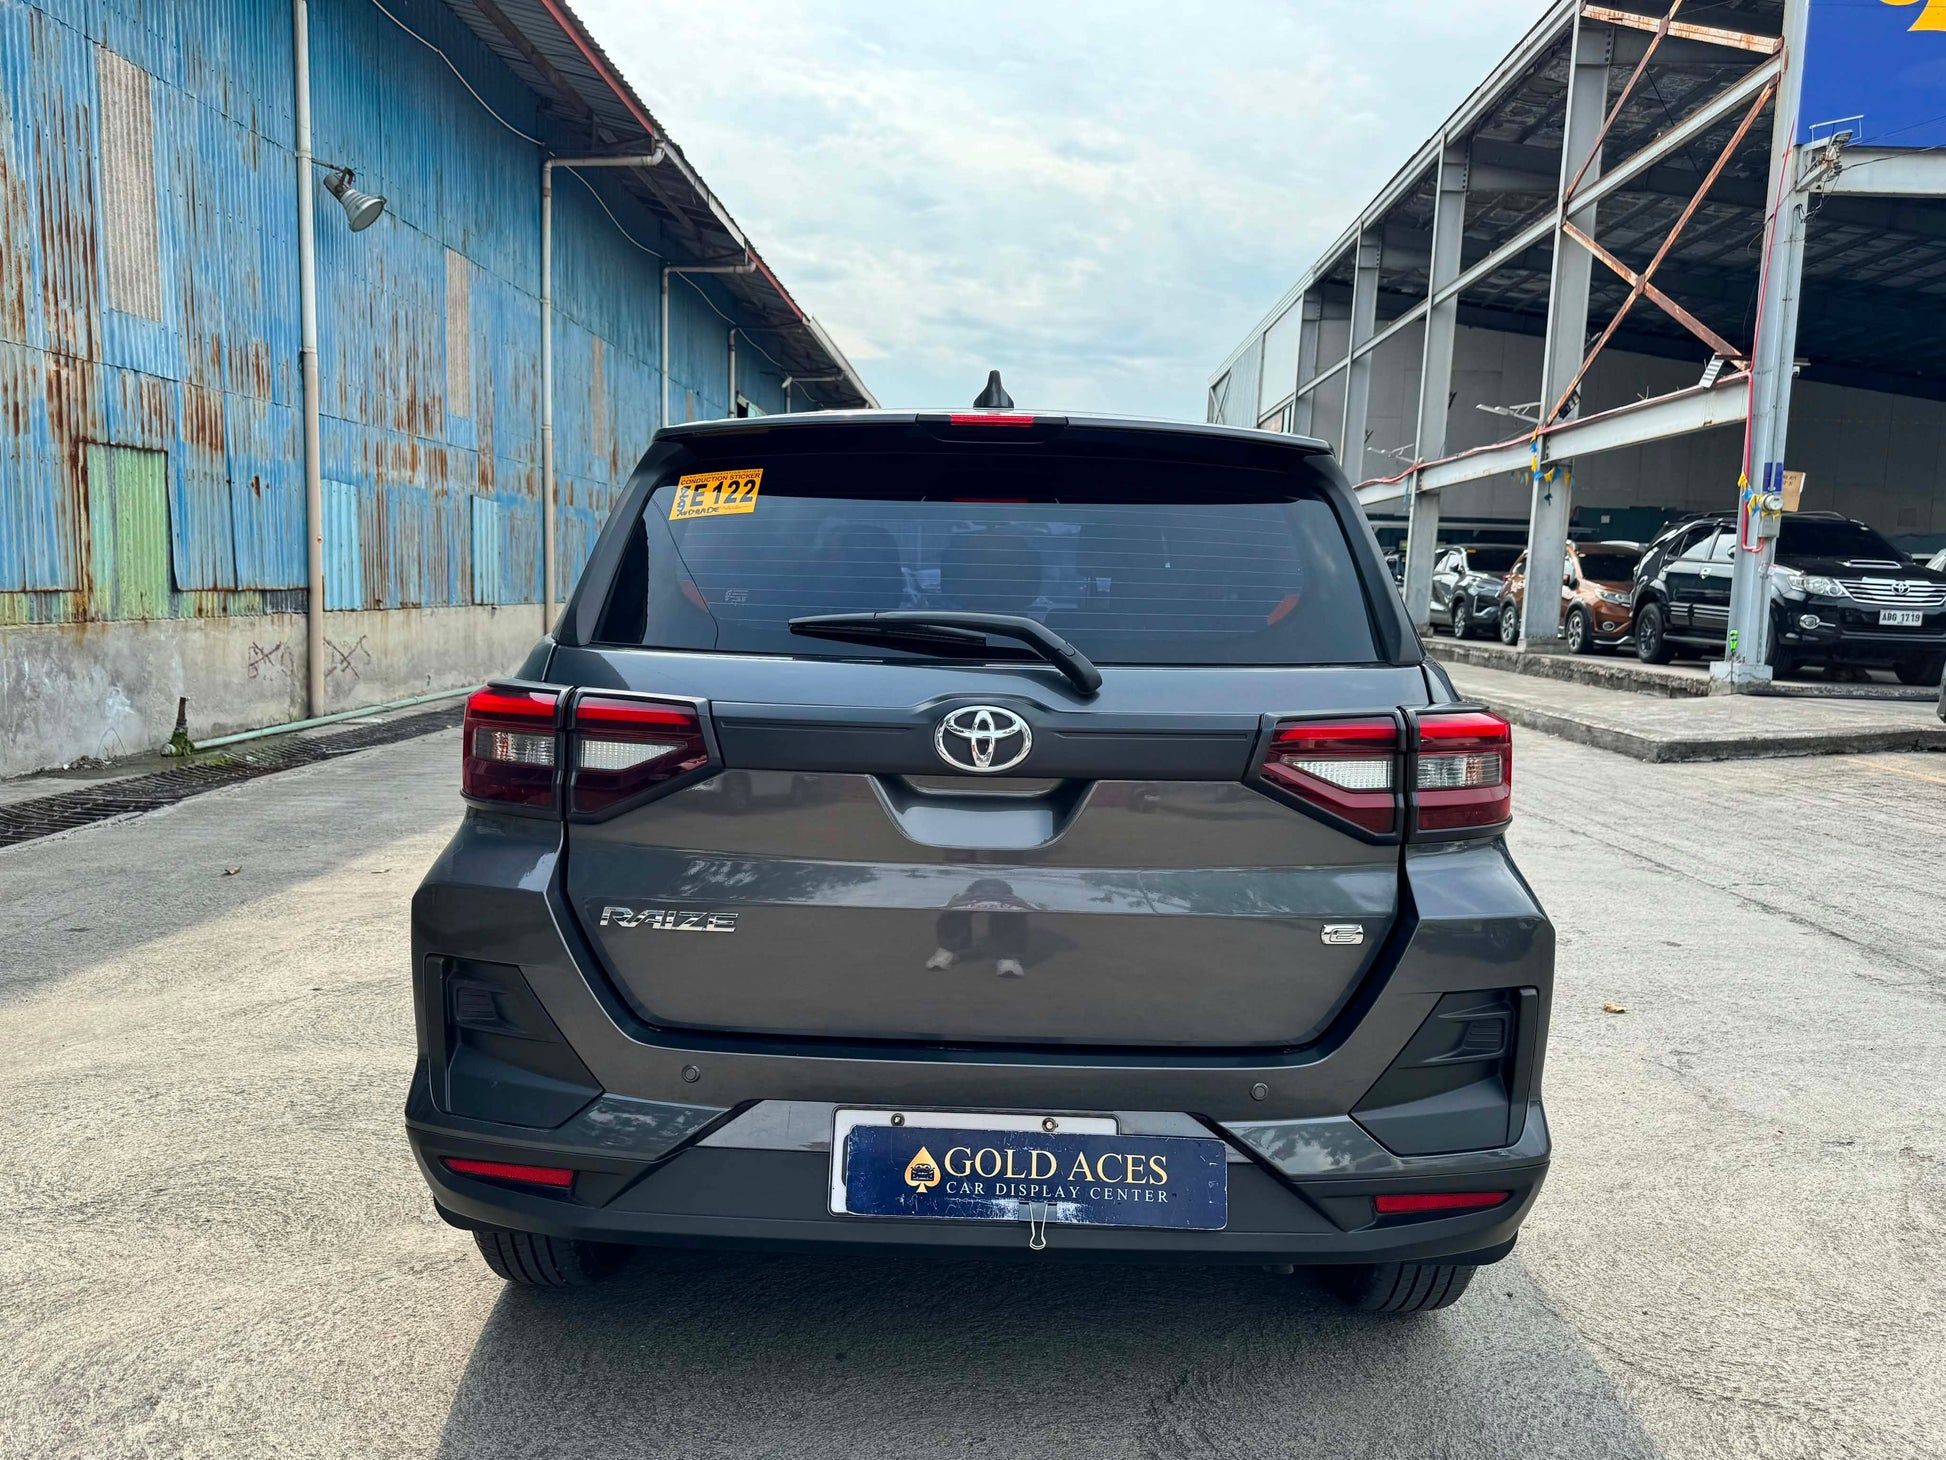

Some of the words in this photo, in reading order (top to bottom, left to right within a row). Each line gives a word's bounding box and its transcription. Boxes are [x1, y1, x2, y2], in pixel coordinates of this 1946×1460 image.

[681, 475, 728, 486] CONDUCTION
[690, 483, 708, 507] E
[712, 479, 757, 504] 122
[599, 906, 739, 932] RAIZE
[944, 1146, 1057, 1179] GOLD
[1067, 1151, 1168, 1185] ACES
[946, 1181, 985, 1195] CAR
[995, 1183, 1082, 1199] DISPLAY
[1090, 1187, 1168, 1203] CENTER
